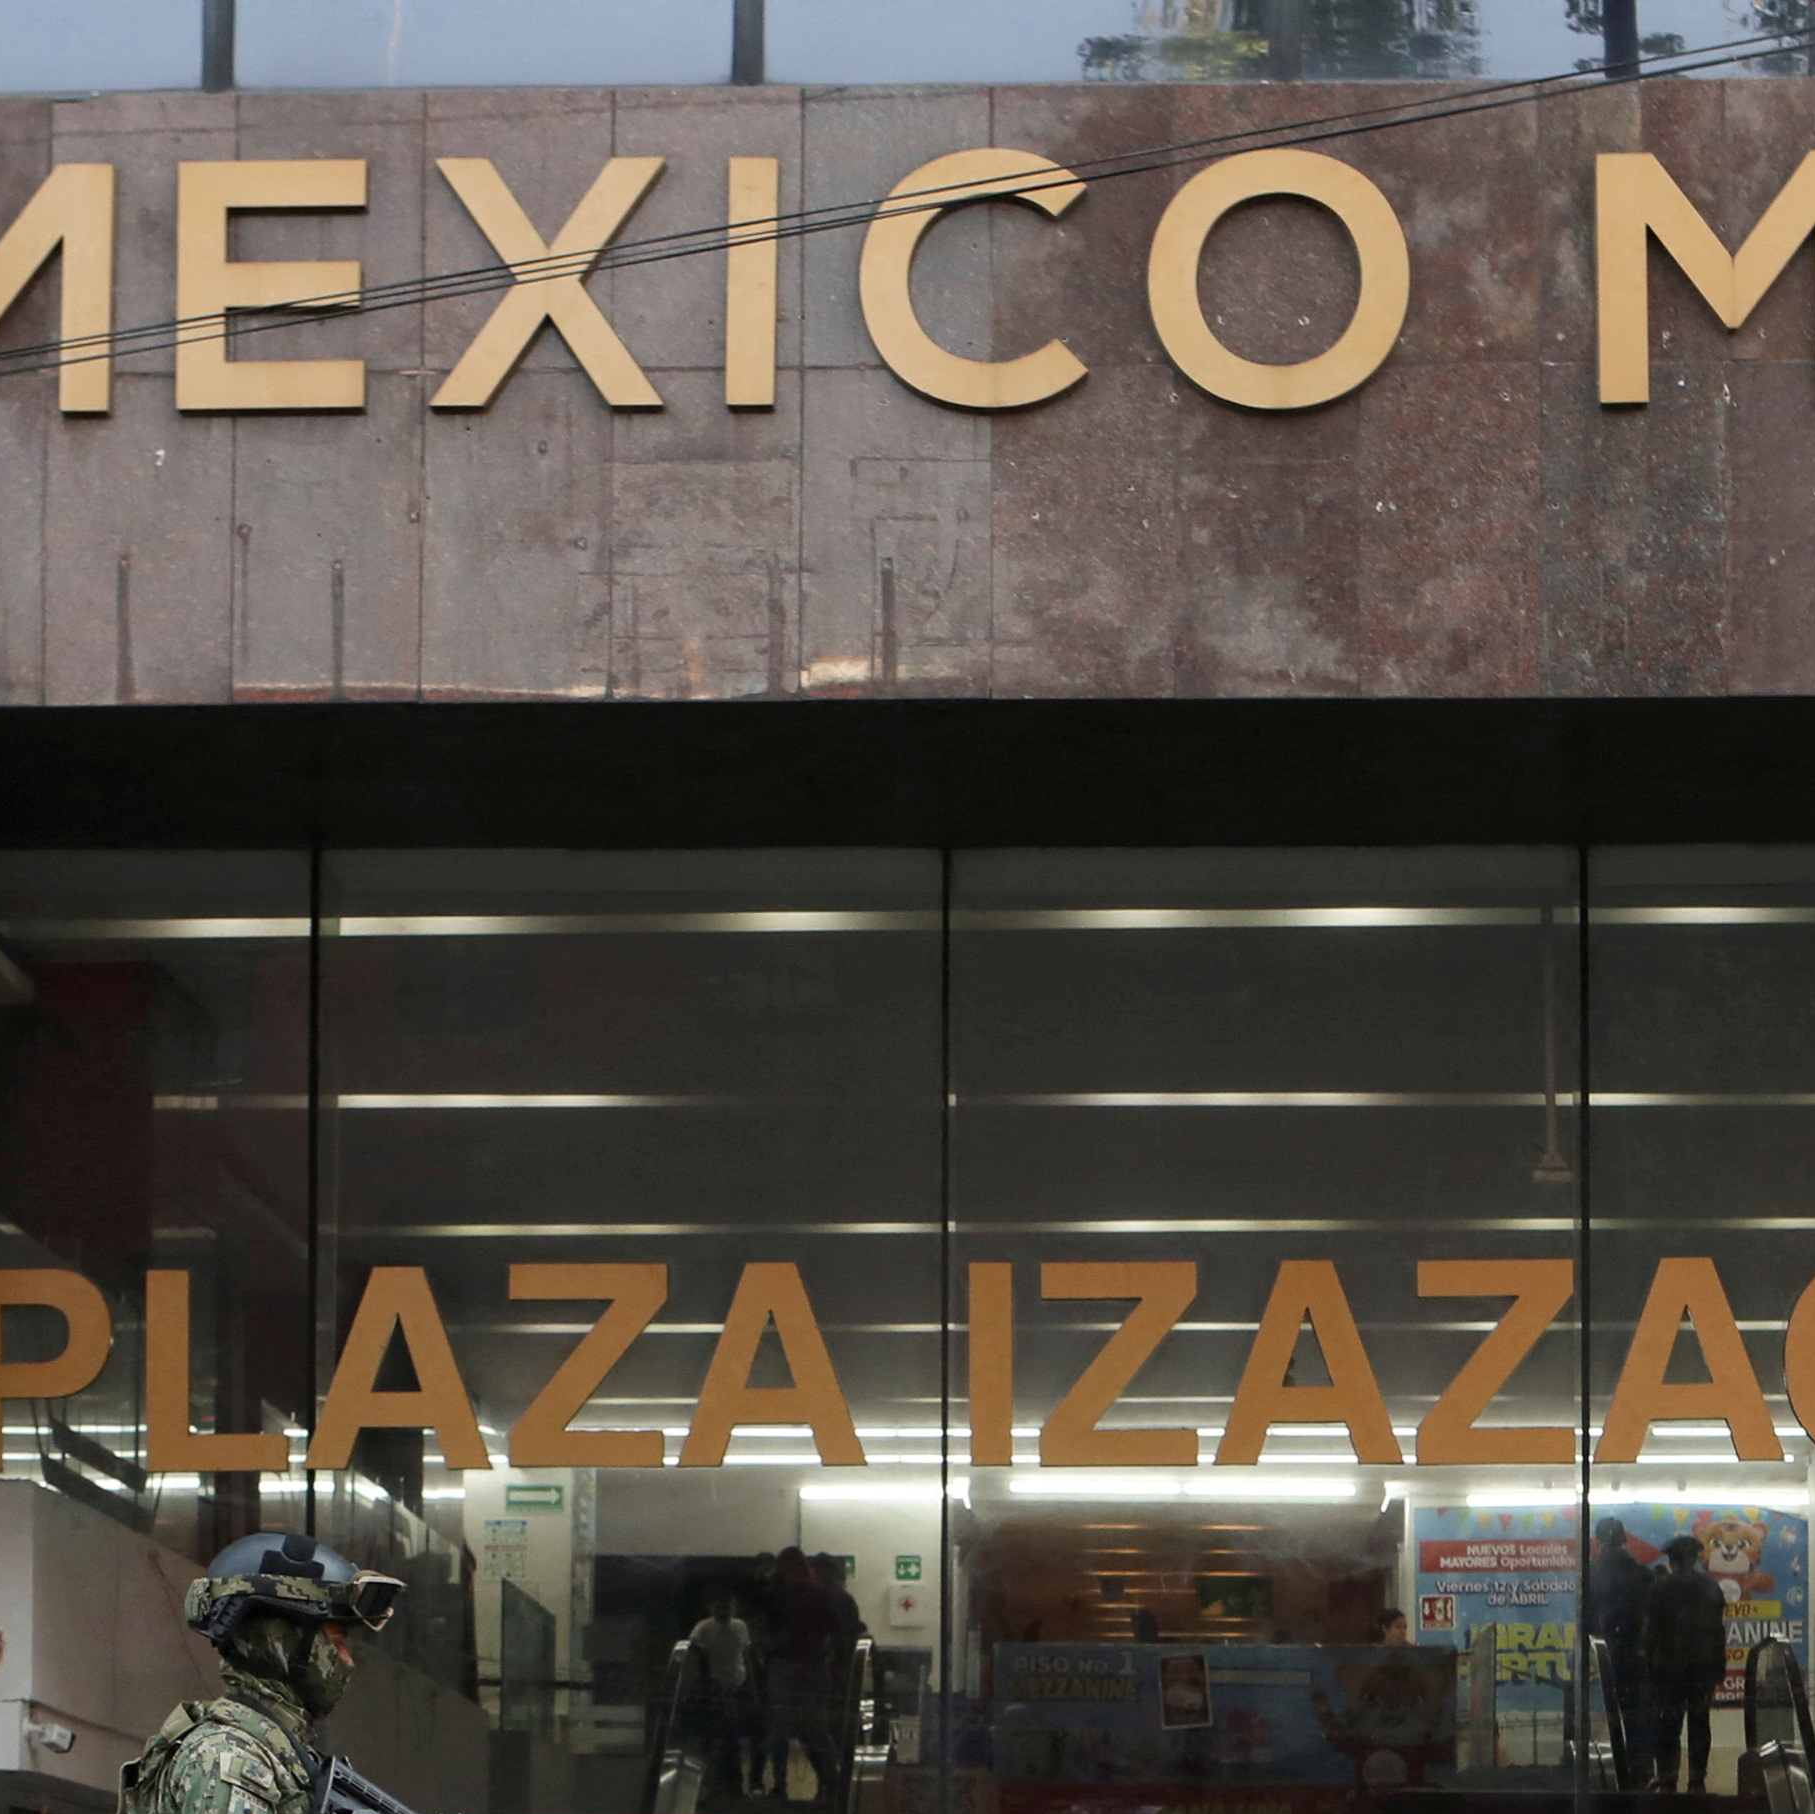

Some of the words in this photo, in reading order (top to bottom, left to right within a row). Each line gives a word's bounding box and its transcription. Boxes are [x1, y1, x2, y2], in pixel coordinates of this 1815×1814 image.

[1466, 1544, 1517, 1556] NUEVOS
[1520, 1544, 1568, 1556] Locales
[1439, 1556, 1498, 1569] MAYORES
[1436, 1580, 1489, 1593] Viernes
[1494, 1581, 1506, 1592] 12
[1487, 1593, 1506, 1605] de
[1510, 1593, 1549, 1606] ABRIL
[1726, 1620, 1804, 1644] ANINE
[1013, 1655, 1071, 1674] PISO
[1119, 1650, 1137, 1676] 1
